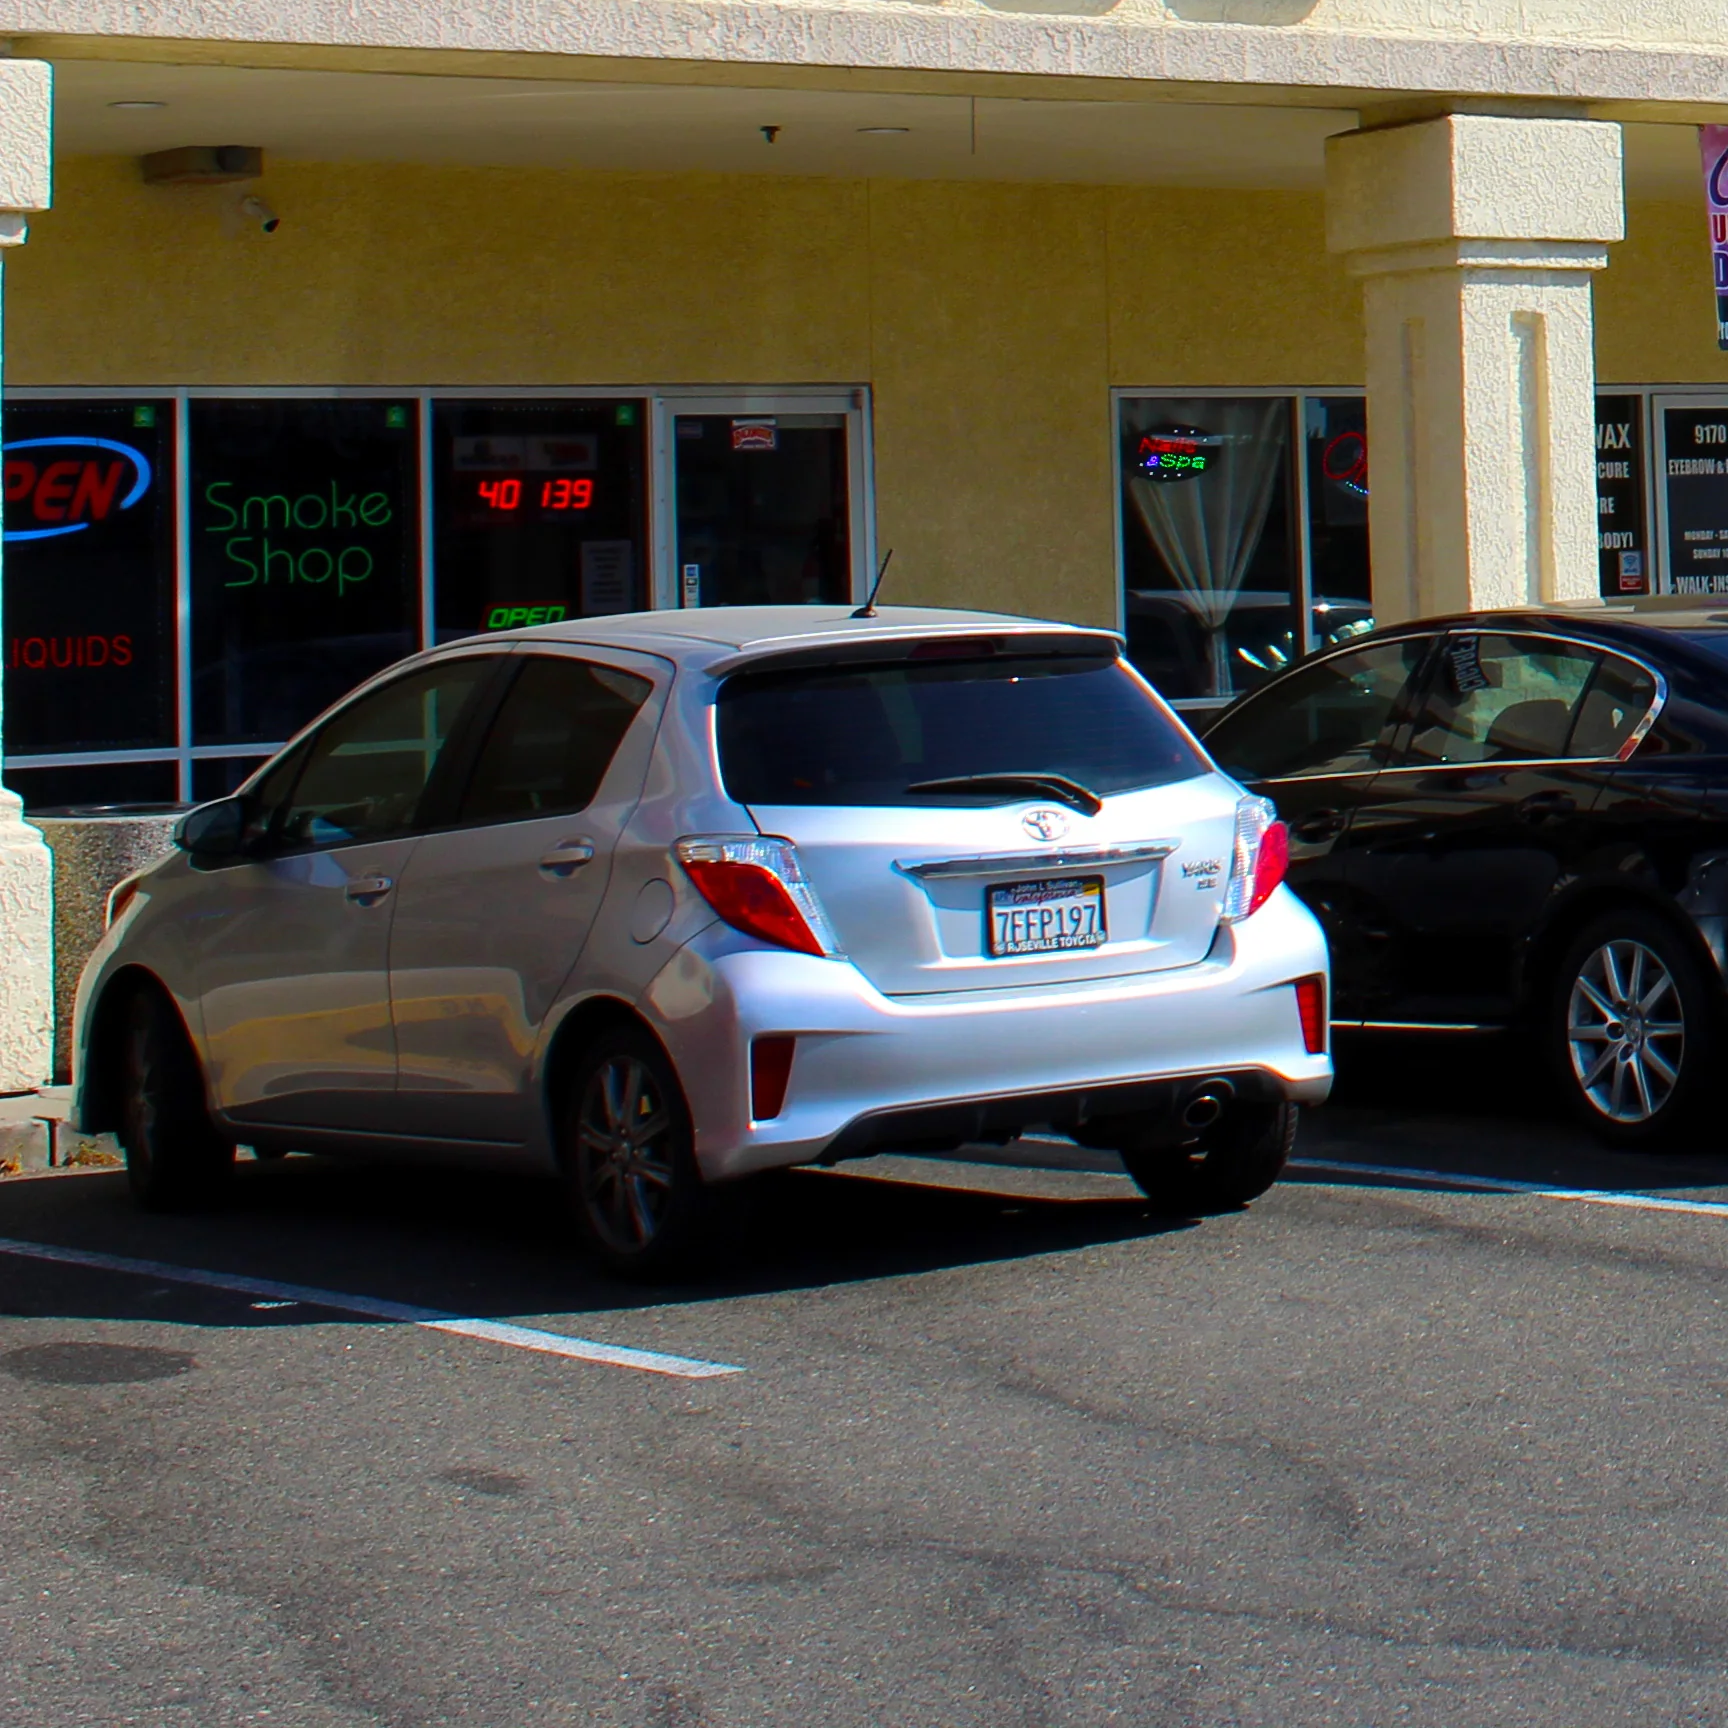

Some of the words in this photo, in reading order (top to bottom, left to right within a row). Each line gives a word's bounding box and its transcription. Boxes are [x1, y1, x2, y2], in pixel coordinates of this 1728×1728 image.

[1694, 424, 1727, 444] 9170
[1160, 453, 1205, 470] Spa
[1669, 459, 1715, 475] EYEBROW
[1717, 461, 1724, 474] &
[205, 479, 391, 531] Smoke
[479, 479, 521, 509] 40
[541, 479, 593, 509] 139
[224, 537, 373, 596] Shop
[487, 605, 566, 629] OPEN
[5, 634, 133, 669] IQUIDS
